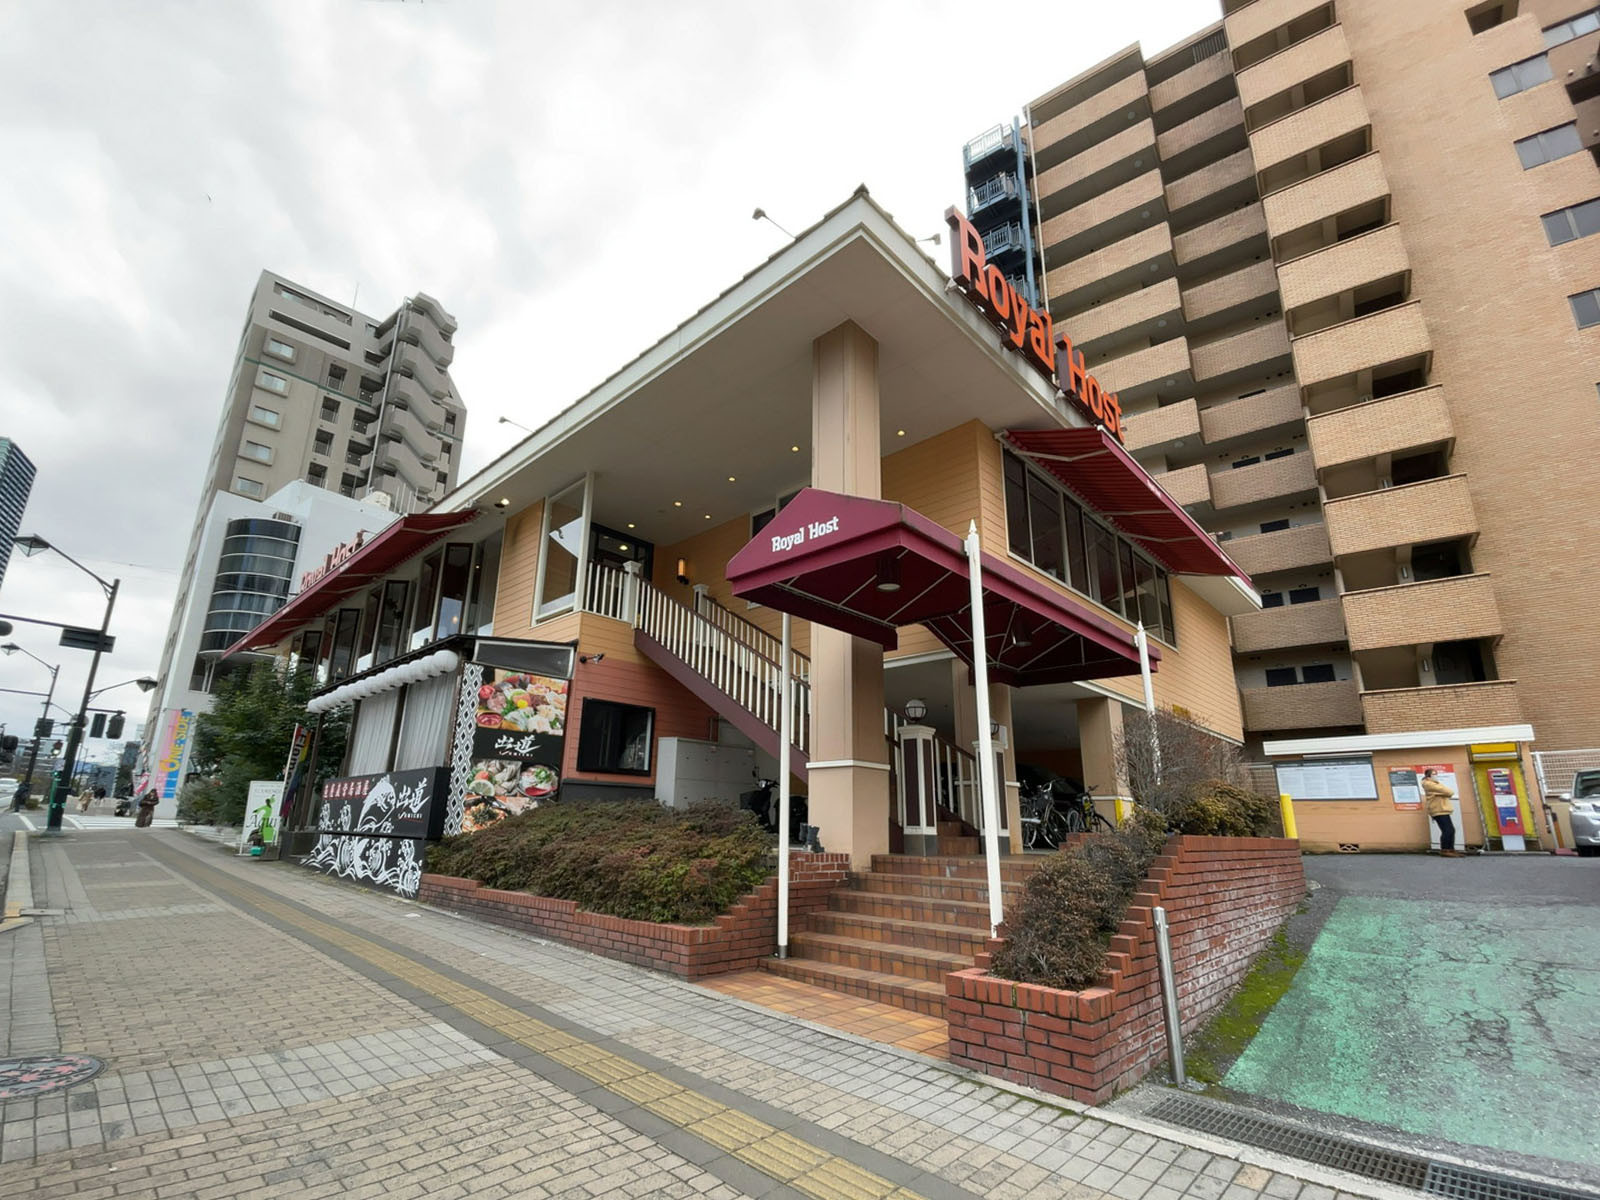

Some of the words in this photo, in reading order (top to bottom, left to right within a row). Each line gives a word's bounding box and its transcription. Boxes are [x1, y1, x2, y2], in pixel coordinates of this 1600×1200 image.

[944, 204, 1056, 373] Royal
[771, 527, 804, 552] Royal
[808, 516, 839, 539] Host
